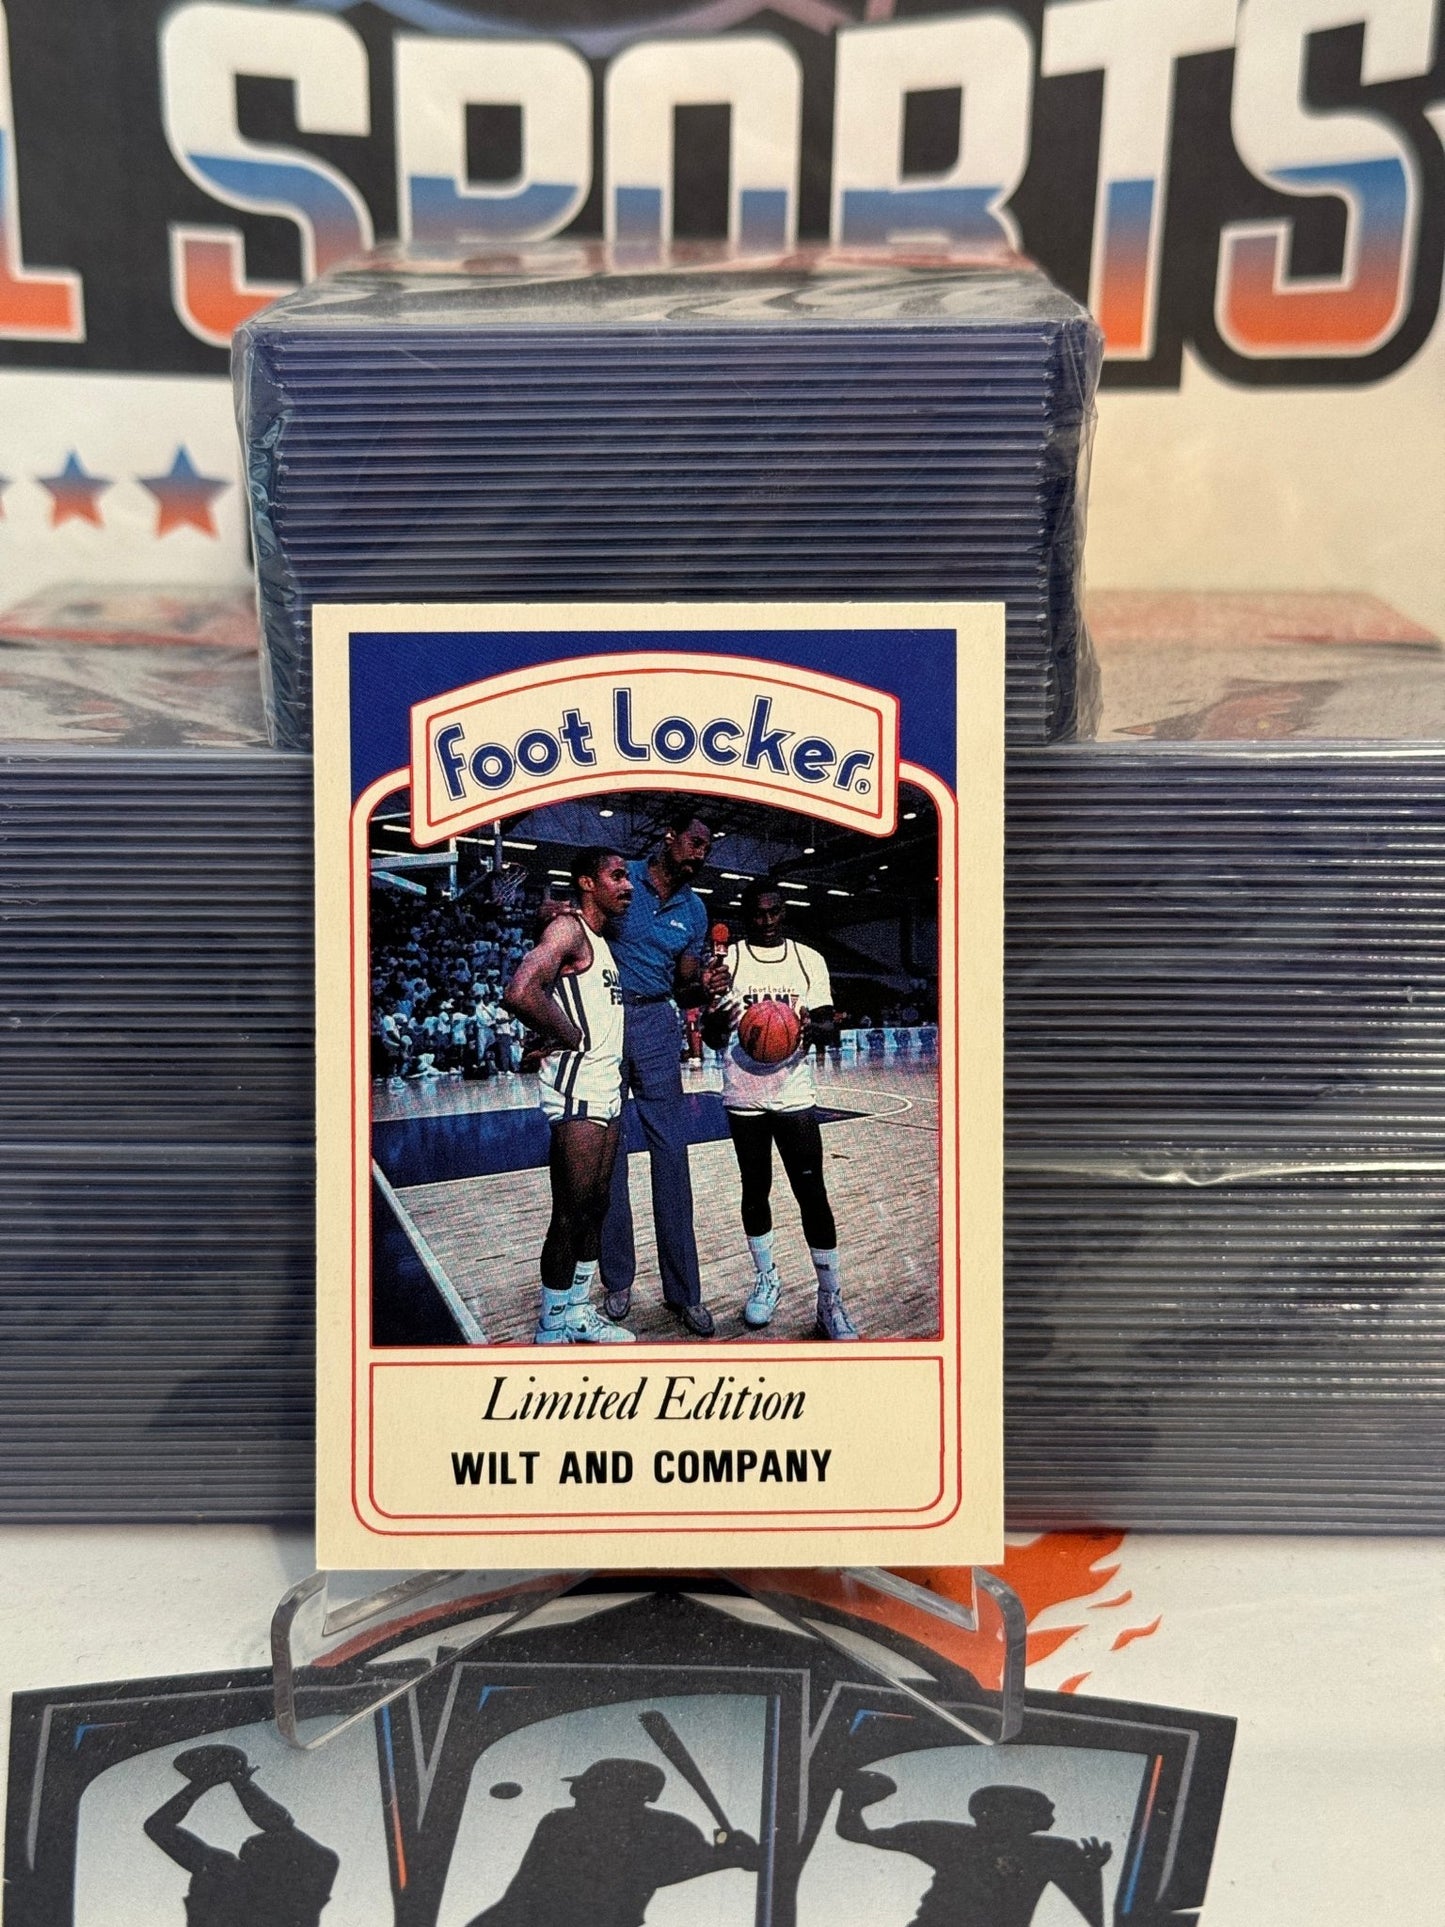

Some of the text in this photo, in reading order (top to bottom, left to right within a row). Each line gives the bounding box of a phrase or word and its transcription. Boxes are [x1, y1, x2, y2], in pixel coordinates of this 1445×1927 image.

[160, 0, 1434, 360] SPORTS
[481, 1375, 807, 1421] Limited Edition
[451, 1448, 832, 1485] WILT AND COMPANY
